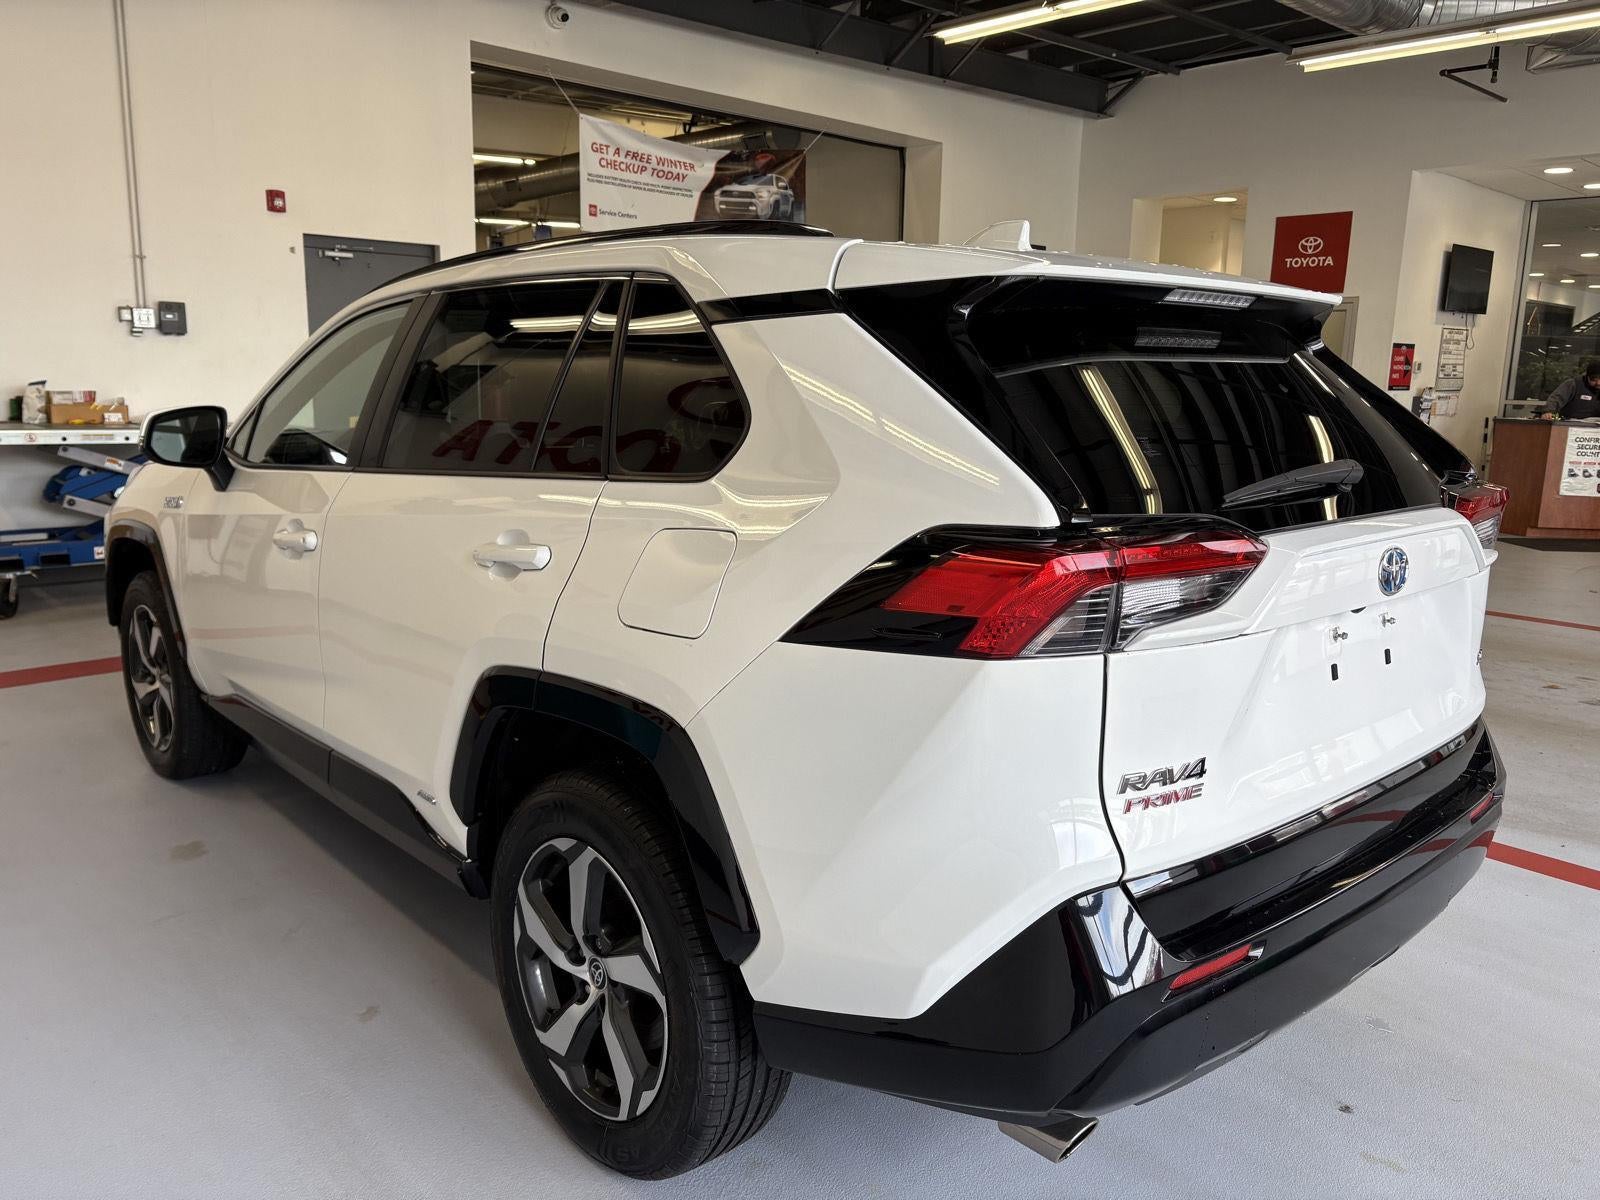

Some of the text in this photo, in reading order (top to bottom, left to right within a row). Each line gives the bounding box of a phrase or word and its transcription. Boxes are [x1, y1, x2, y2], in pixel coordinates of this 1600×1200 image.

[591, 142, 696, 172] GET A FREE WINTER
[598, 157, 648, 175] CHECKUP
[650, 167, 688, 183] TODAY
[599, 208, 638, 220] Service Centers
[1284, 256, 1334, 268] TOYOTA
[1116, 757, 1207, 795] RAV4
[1123, 783, 1204, 814] PRIME
